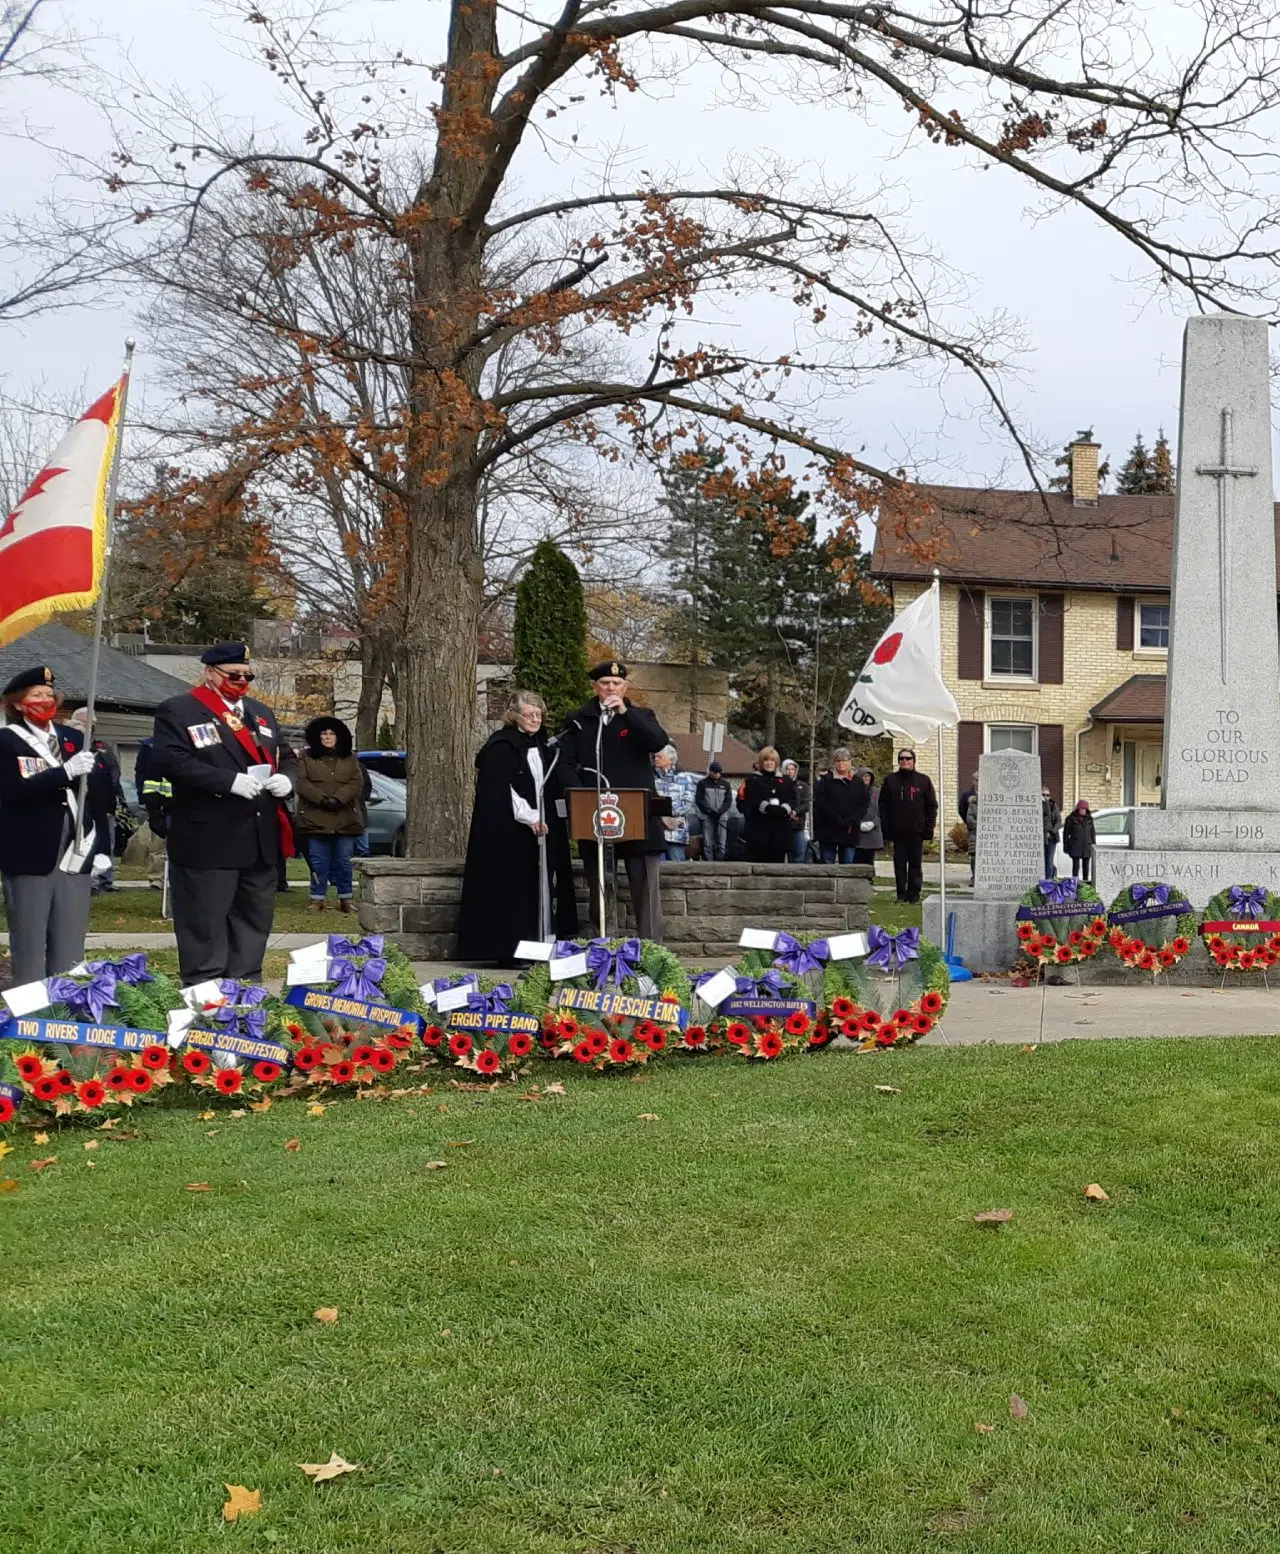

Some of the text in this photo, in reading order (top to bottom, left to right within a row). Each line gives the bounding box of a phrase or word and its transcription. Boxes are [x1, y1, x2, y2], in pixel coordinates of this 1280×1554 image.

[1215, 710, 1240, 725] TO
[1206, 729, 1245, 744] OUR
[1181, 748, 1269, 764] GLORIOUS
[1201, 768, 1250, 783] DEAD
[1110, 863, 1220, 879] WORLD WAR II
[1030, 903, 1082, 912] WELLINGTON
[1117, 910, 1139, 919] COUNTY
[1148, 903, 1184, 913] WELLINGTON
[1232, 923, 1259, 931] CANADA
[303, 992, 404, 1025] GROVES MEMORIAL HOSPITAL
[558, 987, 681, 1024] CW FIRE & RESCUE EMS
[743, 1000, 786, 1009] WELLINGTON
[786, 1000, 809, 1010] RIFLES
[484, 1013, 509, 1029] PIPE
[510, 1015, 539, 1032] BAND
[17, 1019, 157, 1048] TWO RIVERS LODGE NO 203
[184, 1029, 290, 1064] FERGUS SCOTTISH FESTIVAL
